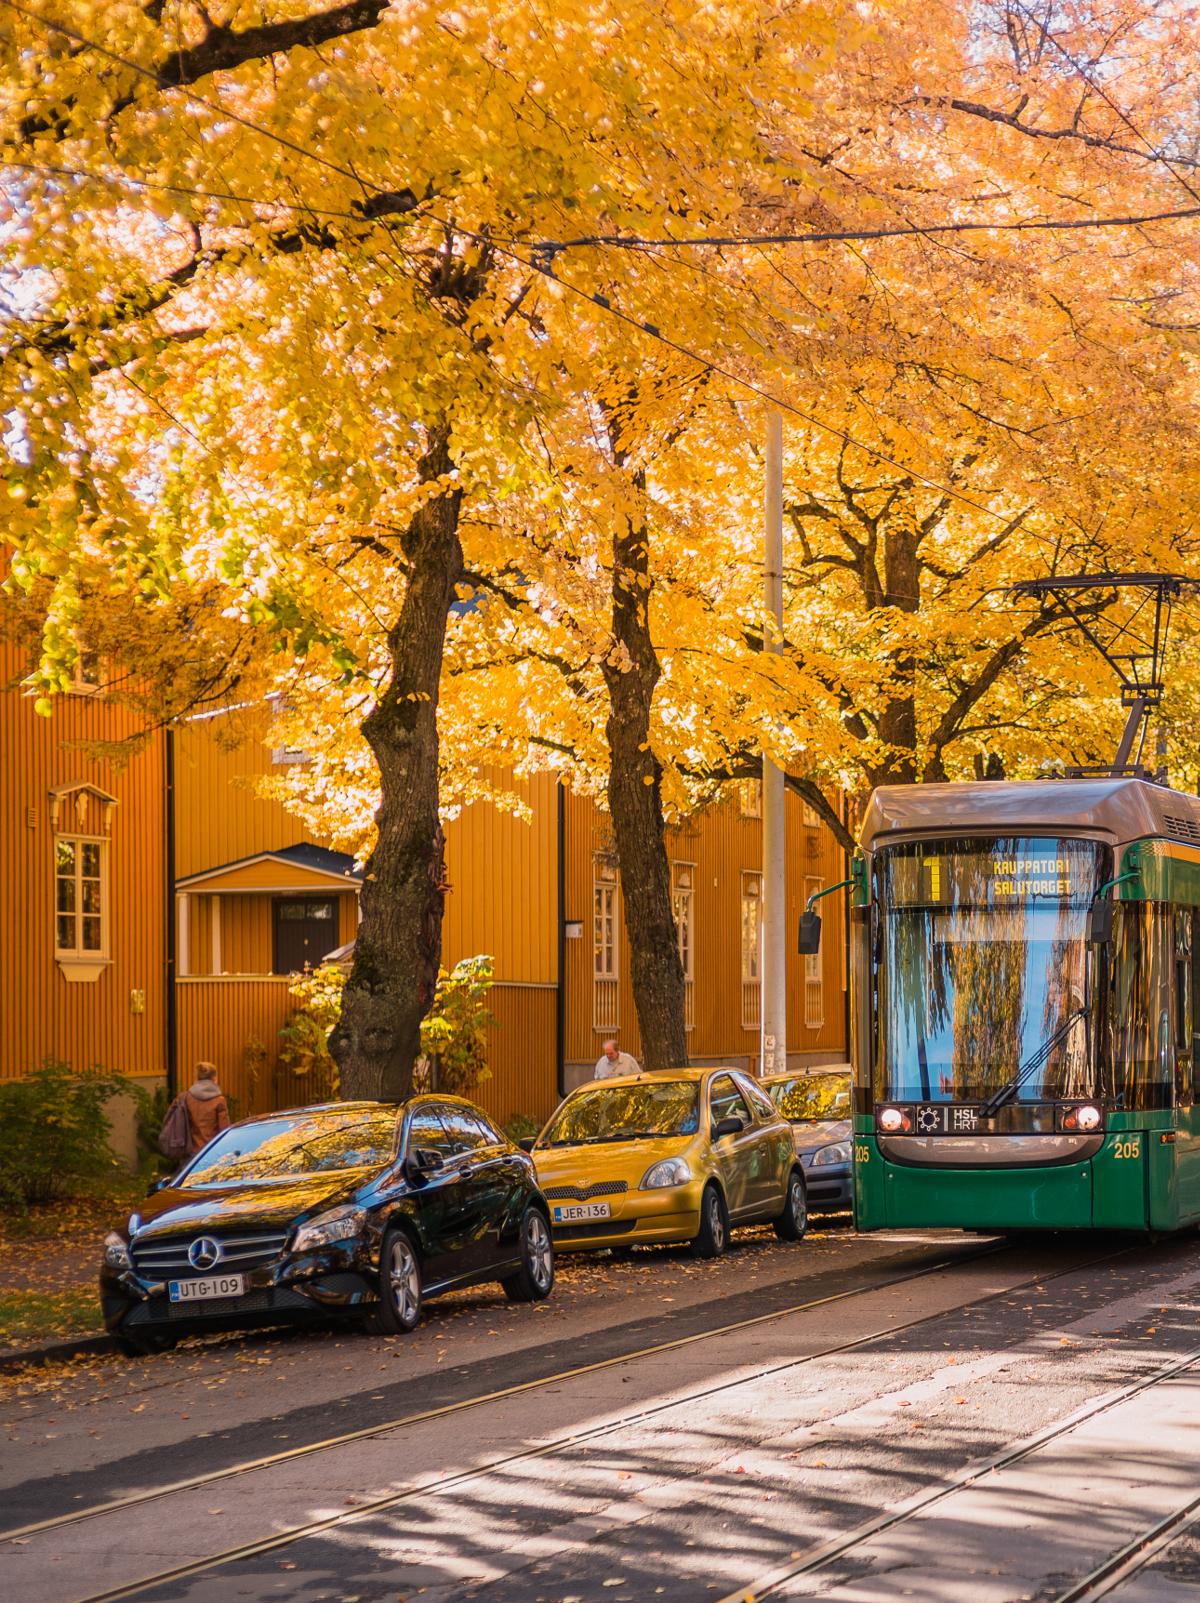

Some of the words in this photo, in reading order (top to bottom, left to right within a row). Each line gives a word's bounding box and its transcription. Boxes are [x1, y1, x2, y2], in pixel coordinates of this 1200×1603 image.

[994, 860, 1070, 875] KAUPPATORI
[923, 857, 940, 901] 1
[994, 880, 1071, 895] SALUTORGET
[953, 1109, 977, 1120] HSL
[953, 1120, 978, 1130] HRT
[1114, 1142, 1140, 1158] 205
[563, 1205, 607, 1219] JER-136
[180, 1278, 239, 1297] UTG-109
